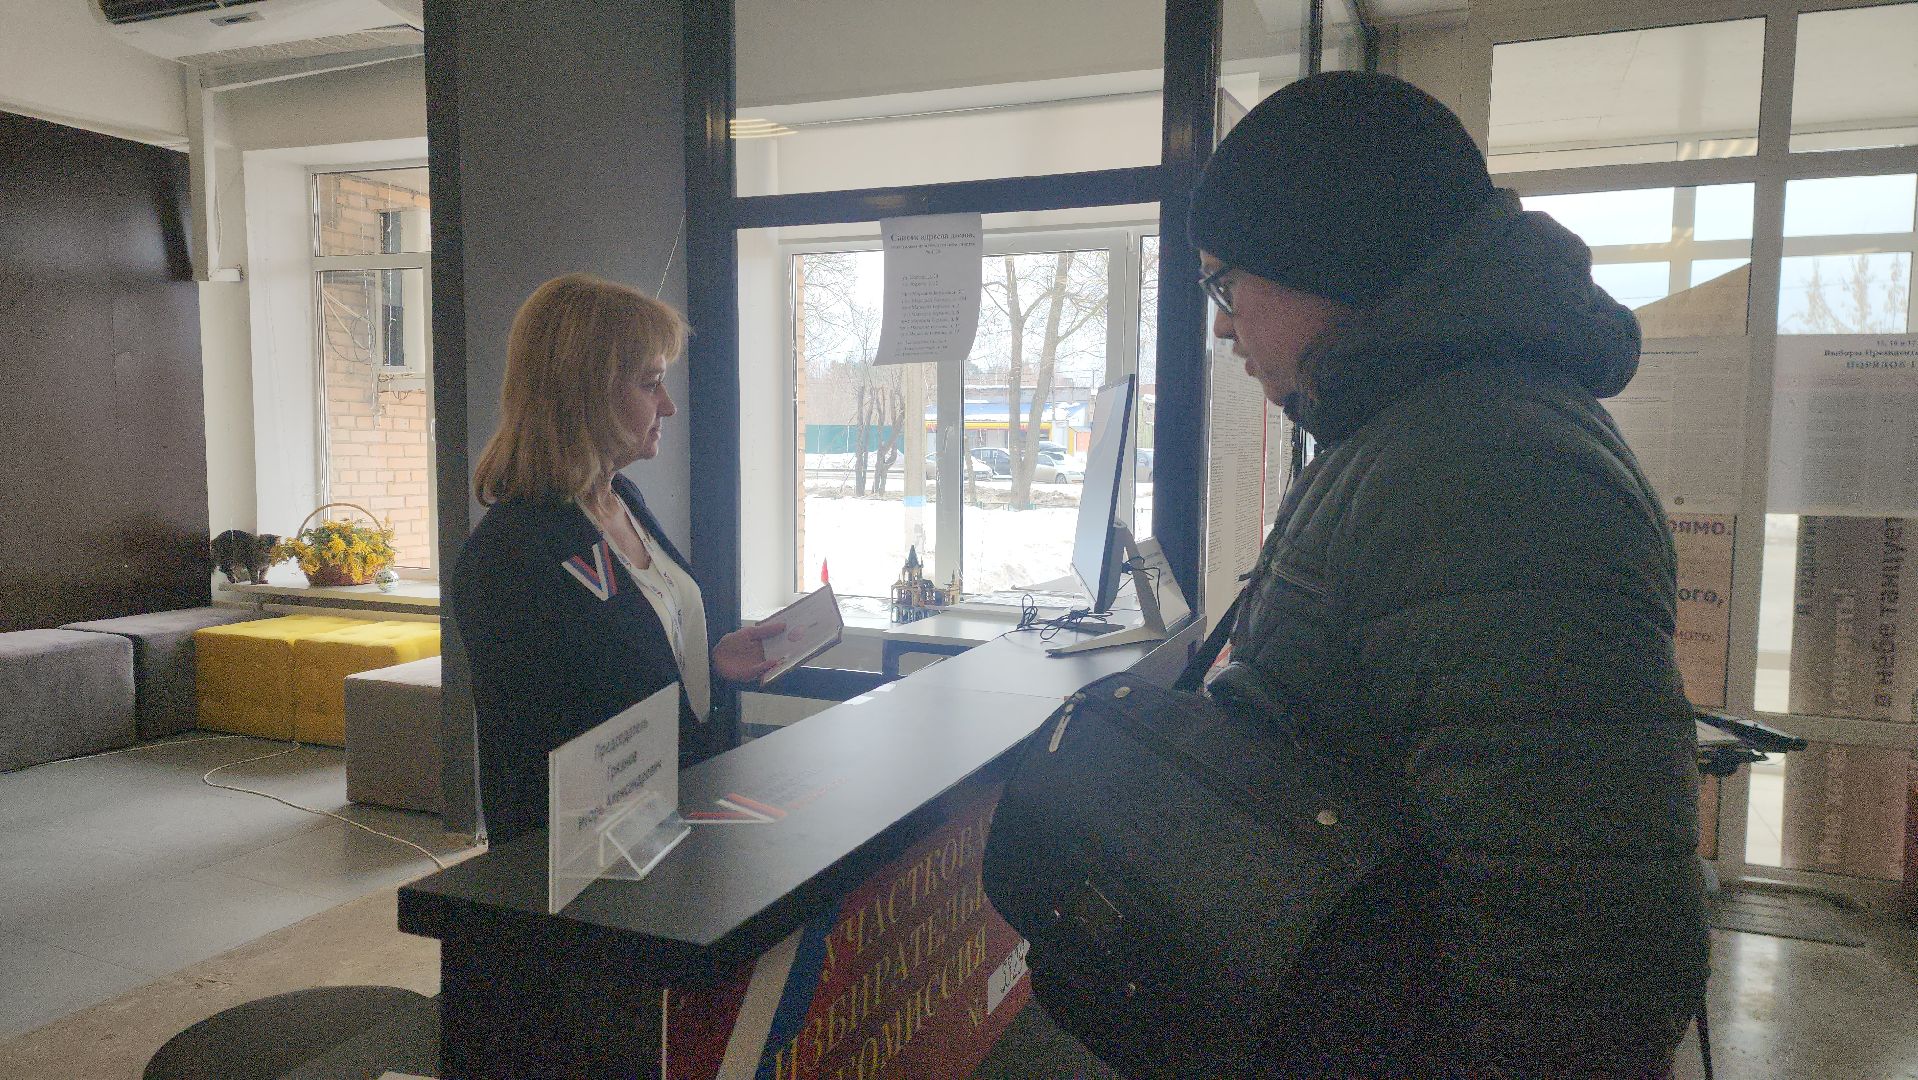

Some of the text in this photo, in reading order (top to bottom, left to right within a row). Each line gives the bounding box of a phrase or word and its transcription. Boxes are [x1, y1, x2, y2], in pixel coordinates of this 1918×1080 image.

[1824, 349, 1863, 358] Выборы
[1846, 360, 1906, 370] ПОРЯДОК
[1871, 622, 1897, 686] небе
[823, 808, 994, 983] УЧАСТКОВА
[838, 922, 988, 1080] ОМИССИЯ
